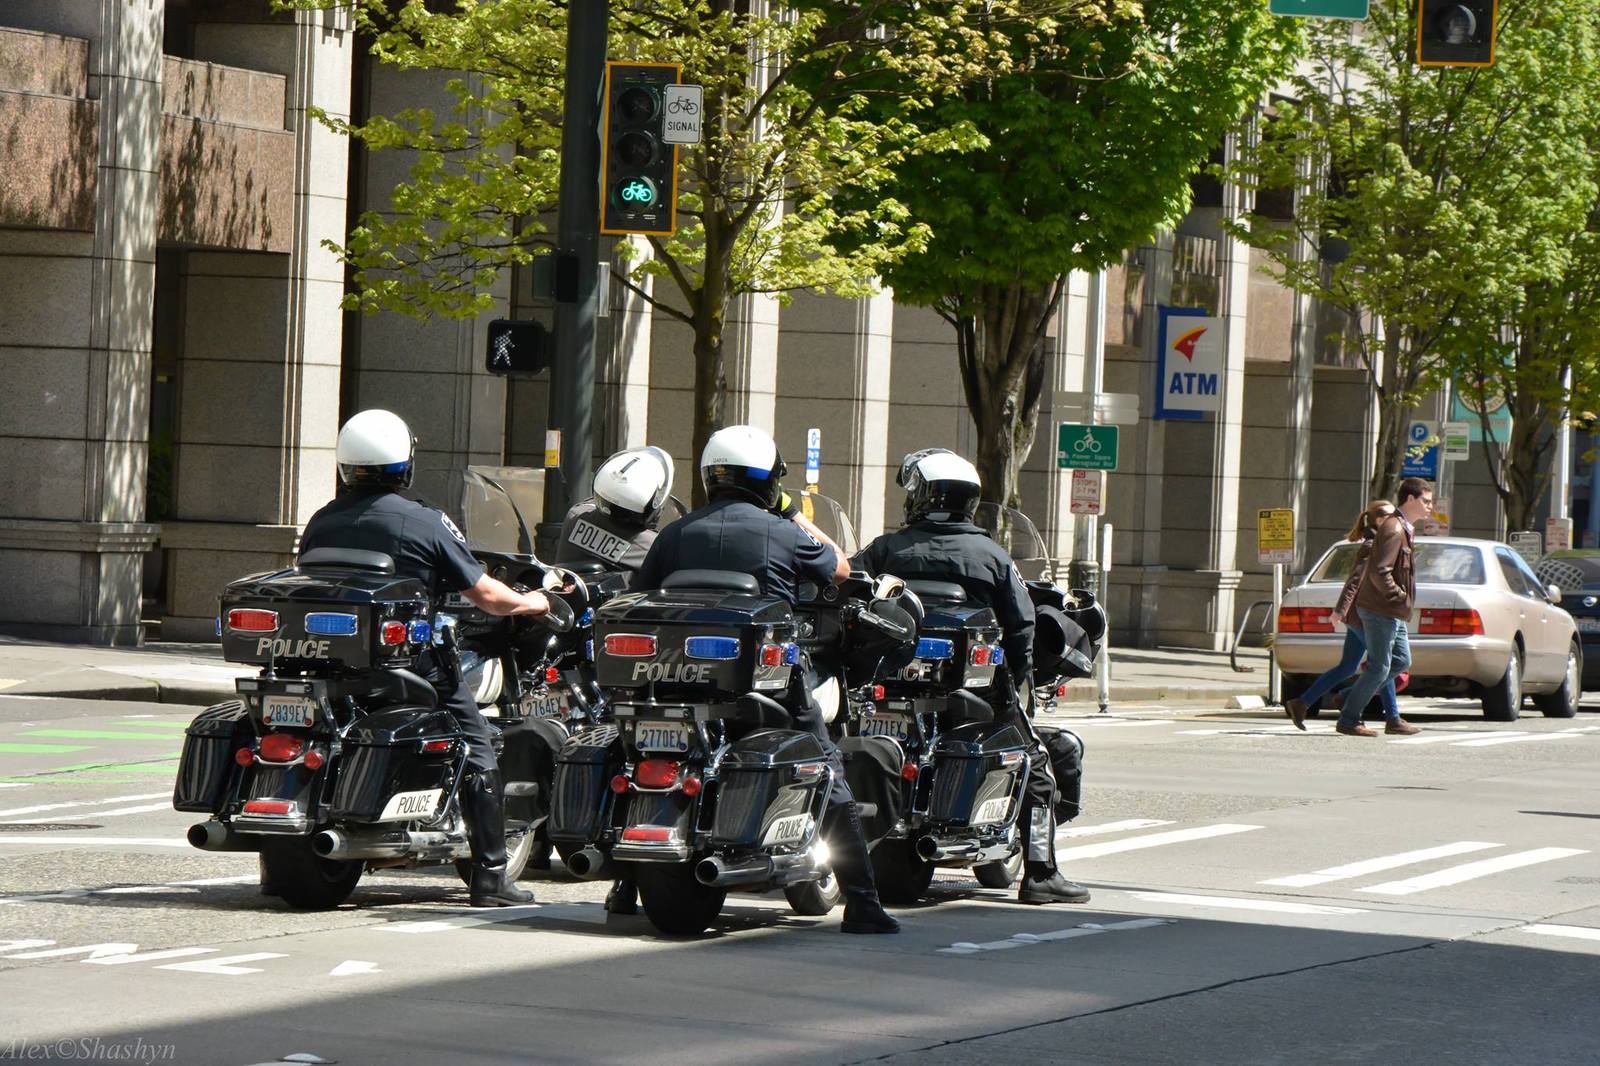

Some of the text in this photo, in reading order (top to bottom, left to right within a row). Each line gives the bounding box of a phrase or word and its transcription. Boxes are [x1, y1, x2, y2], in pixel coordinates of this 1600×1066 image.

[667, 121, 698, 132] SIGNAL
[1169, 372, 1217, 395] ATM
[1415, 427, 1424, 438] P
[572, 522, 625, 559] POLICE
[256, 638, 331, 659] POLICE
[632, 662, 712, 683] POLICE
[269, 704, 308, 723] 2839EX
[526, 696, 561, 718] 2764EX
[865, 719, 903, 737] 2771EX
[642, 729, 683, 748] 2770EX
[396, 794, 431, 814] POLICE
[982, 800, 1007, 820] POLICE
[774, 818, 803, 840] POLICE
